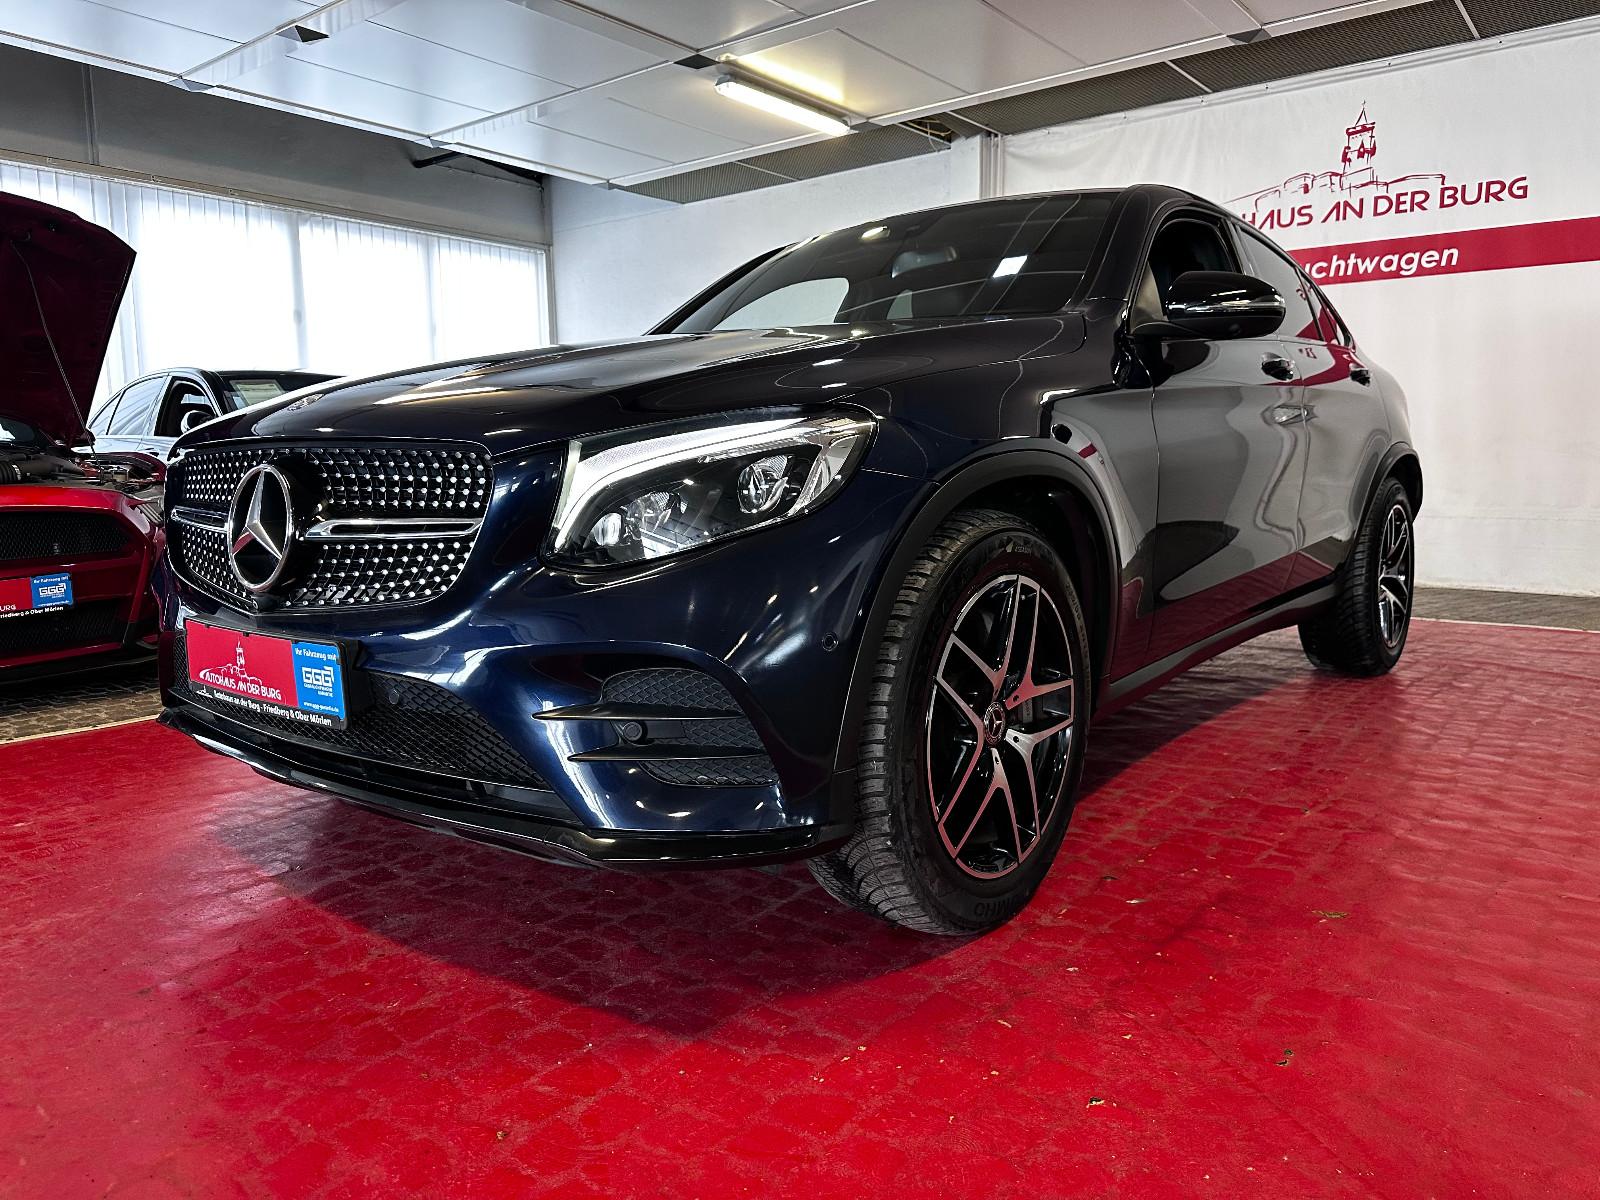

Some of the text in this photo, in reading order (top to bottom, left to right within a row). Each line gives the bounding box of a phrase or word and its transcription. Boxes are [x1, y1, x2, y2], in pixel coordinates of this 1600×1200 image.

[1321, 198, 1364, 223] AN
[1372, 190, 1430, 217] DER
[1439, 176, 1529, 209] BURG
[38, 583, 67, 595] GGG
[303, 648, 327, 661] Fahrzeug
[327, 652, 337, 661] mit
[205, 671, 282, 700] AUTOHAUS AN DER BURG
[301, 666, 335, 688] GGG
[247, 698, 261, 712] Burg
[263, 703, 290, 719] Friedberg
[295, 710, 310, 722] Ober
[310, 714, 332, 726] Mörlen
